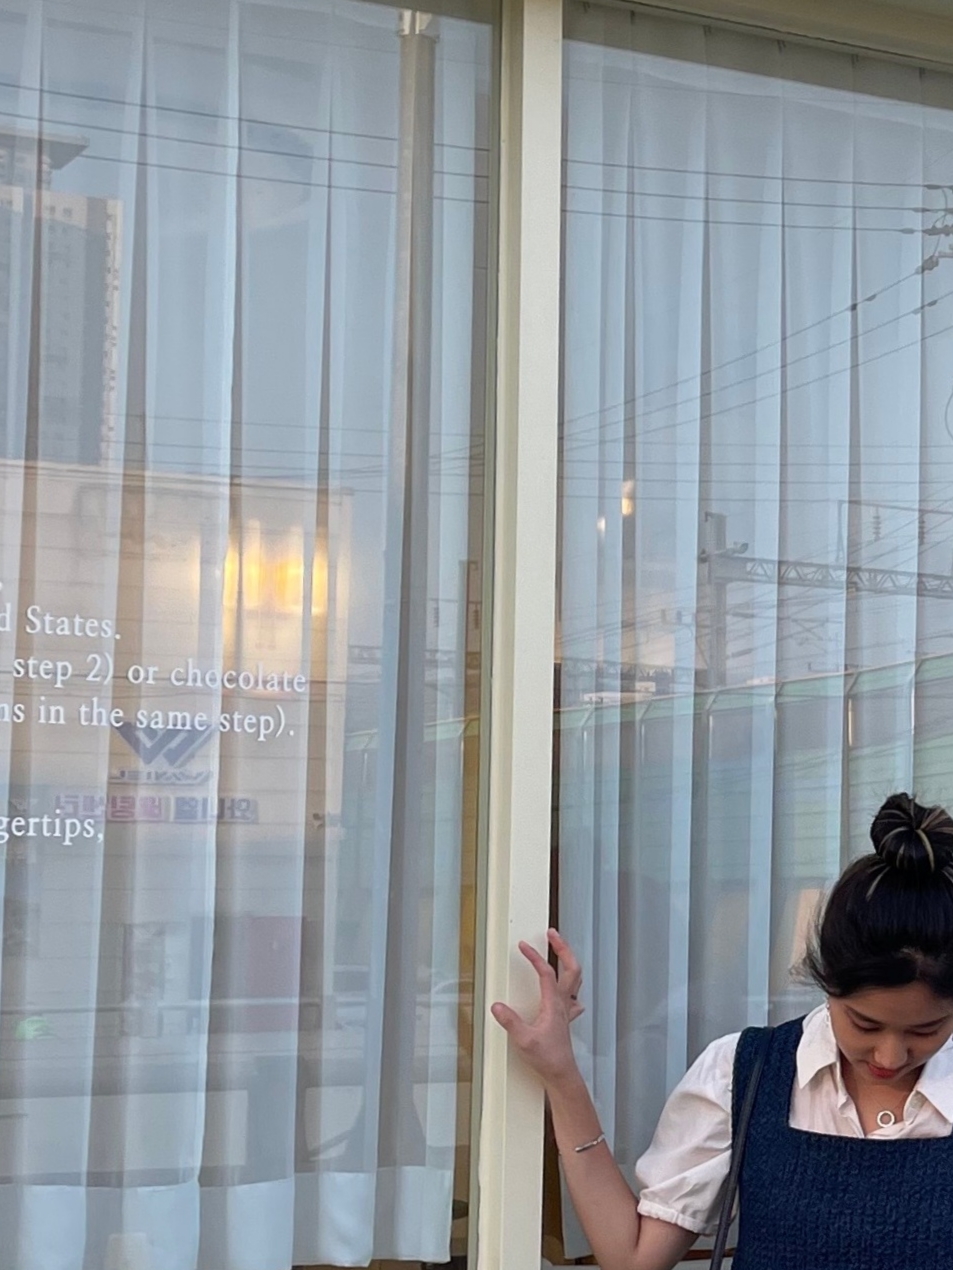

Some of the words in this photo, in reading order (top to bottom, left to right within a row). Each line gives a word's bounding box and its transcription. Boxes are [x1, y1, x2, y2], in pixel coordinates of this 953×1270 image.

[25, 605, 121, 640] States.
[12, 657, 72, 688] step
[86, 652, 114, 685] 2)
[127, 664, 158, 685] or
[170, 658, 307, 693] chocolate
[38, 696, 66, 725] in
[79, 696, 125, 727] the
[136, 708, 208, 733] same
[219, 705, 295, 741] step).
